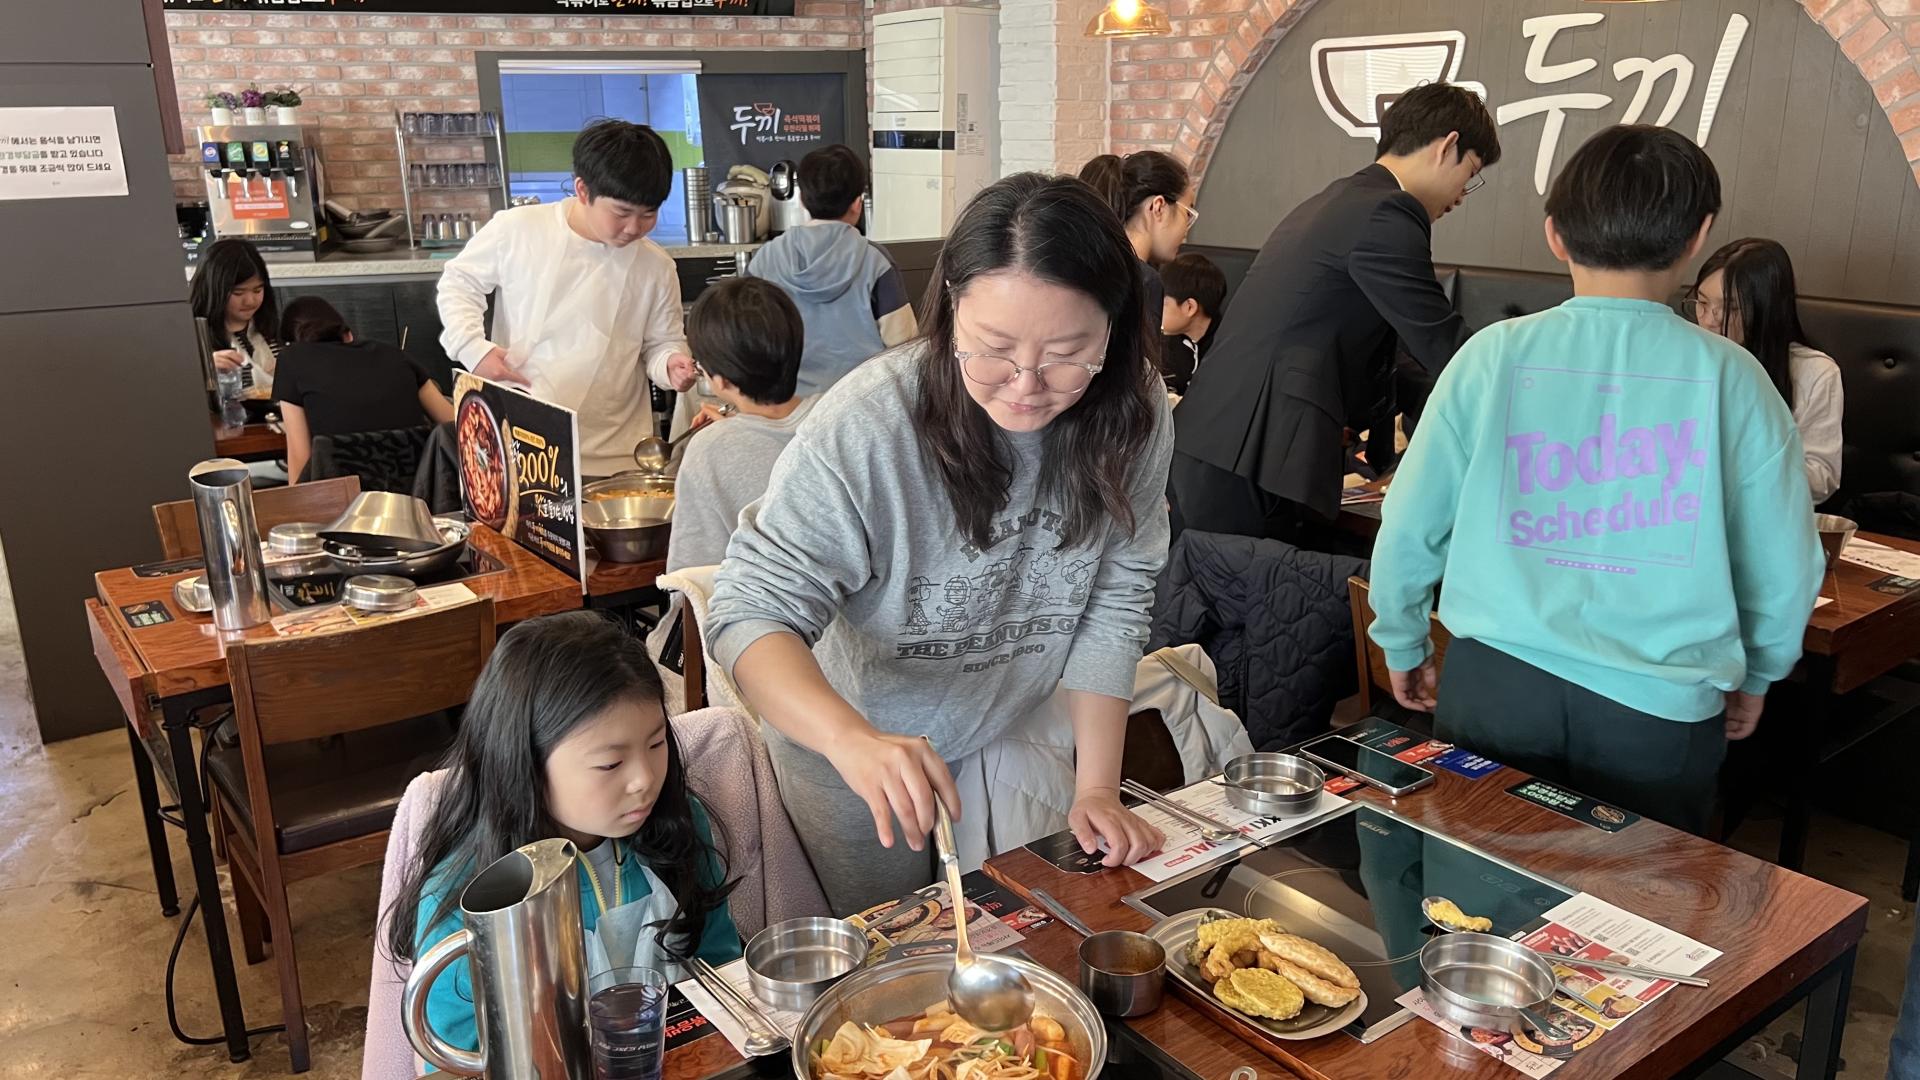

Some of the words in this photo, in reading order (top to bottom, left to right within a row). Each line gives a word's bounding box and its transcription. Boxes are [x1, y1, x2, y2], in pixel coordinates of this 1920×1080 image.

[1497, 12, 1750, 196] 두끼
[67, 136, 101, 144] 남기시면
[730, 106, 781, 145] 두끼
[70, 149, 104, 158] 있습니다
[87, 162, 112, 171] 드세요
[1505, 413, 1707, 495] Today.
[1510, 488, 1701, 547] Schedule
[897, 643, 948, 657] THE
[954, 618, 1051, 655] PEANUTS
[963, 653, 1010, 673] SINCE
